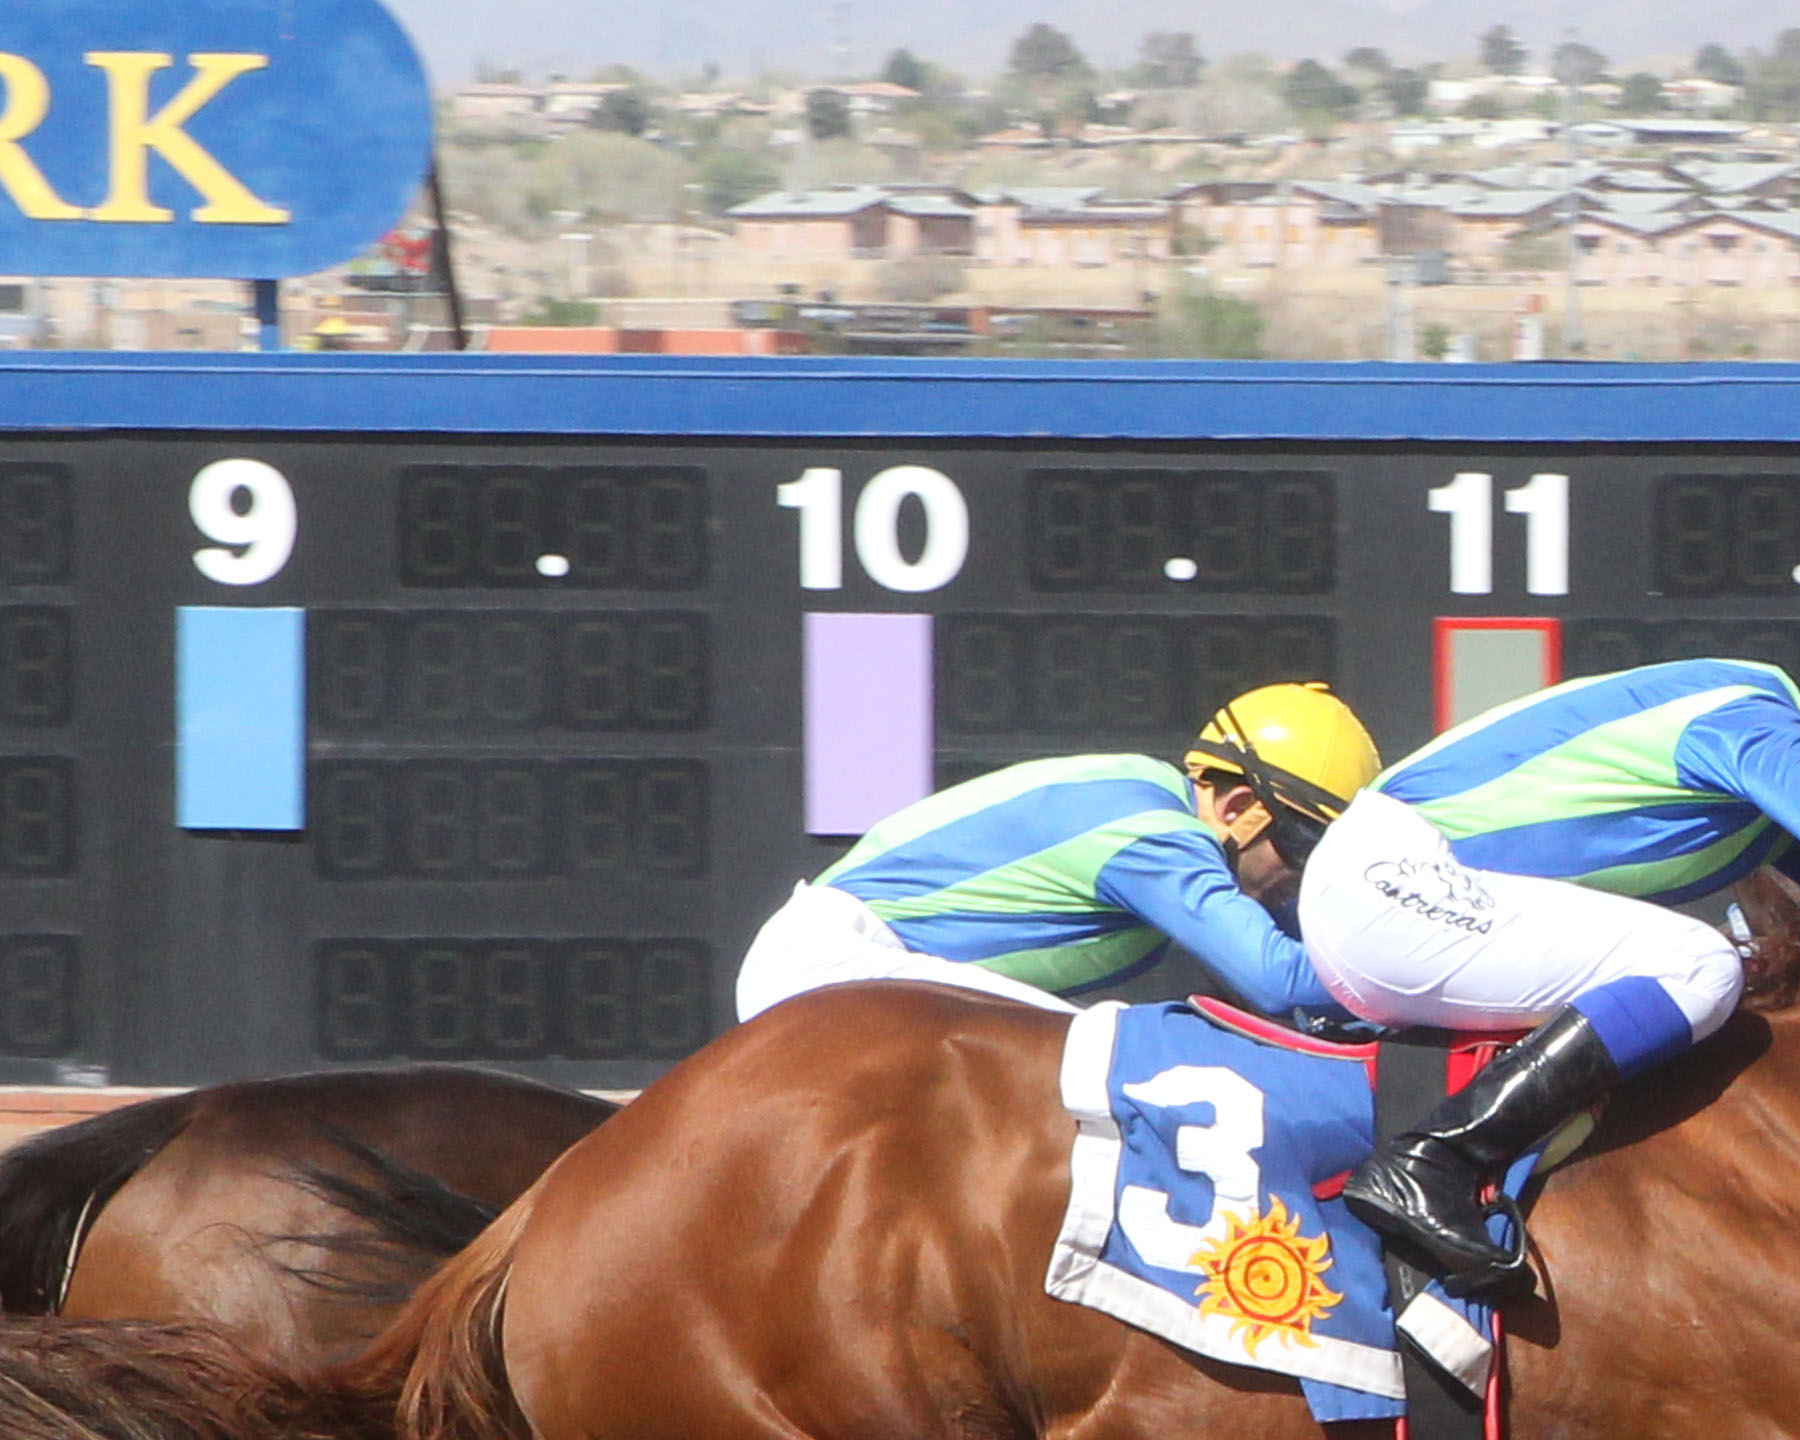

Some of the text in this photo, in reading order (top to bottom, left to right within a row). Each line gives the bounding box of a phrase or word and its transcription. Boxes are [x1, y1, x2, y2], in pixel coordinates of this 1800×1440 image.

[189, 458, 298, 586] 9
[776, 466, 970, 592] 10
[1428, 472, 1570, 596] 11
[1117, 1065, 1264, 1276] 3
